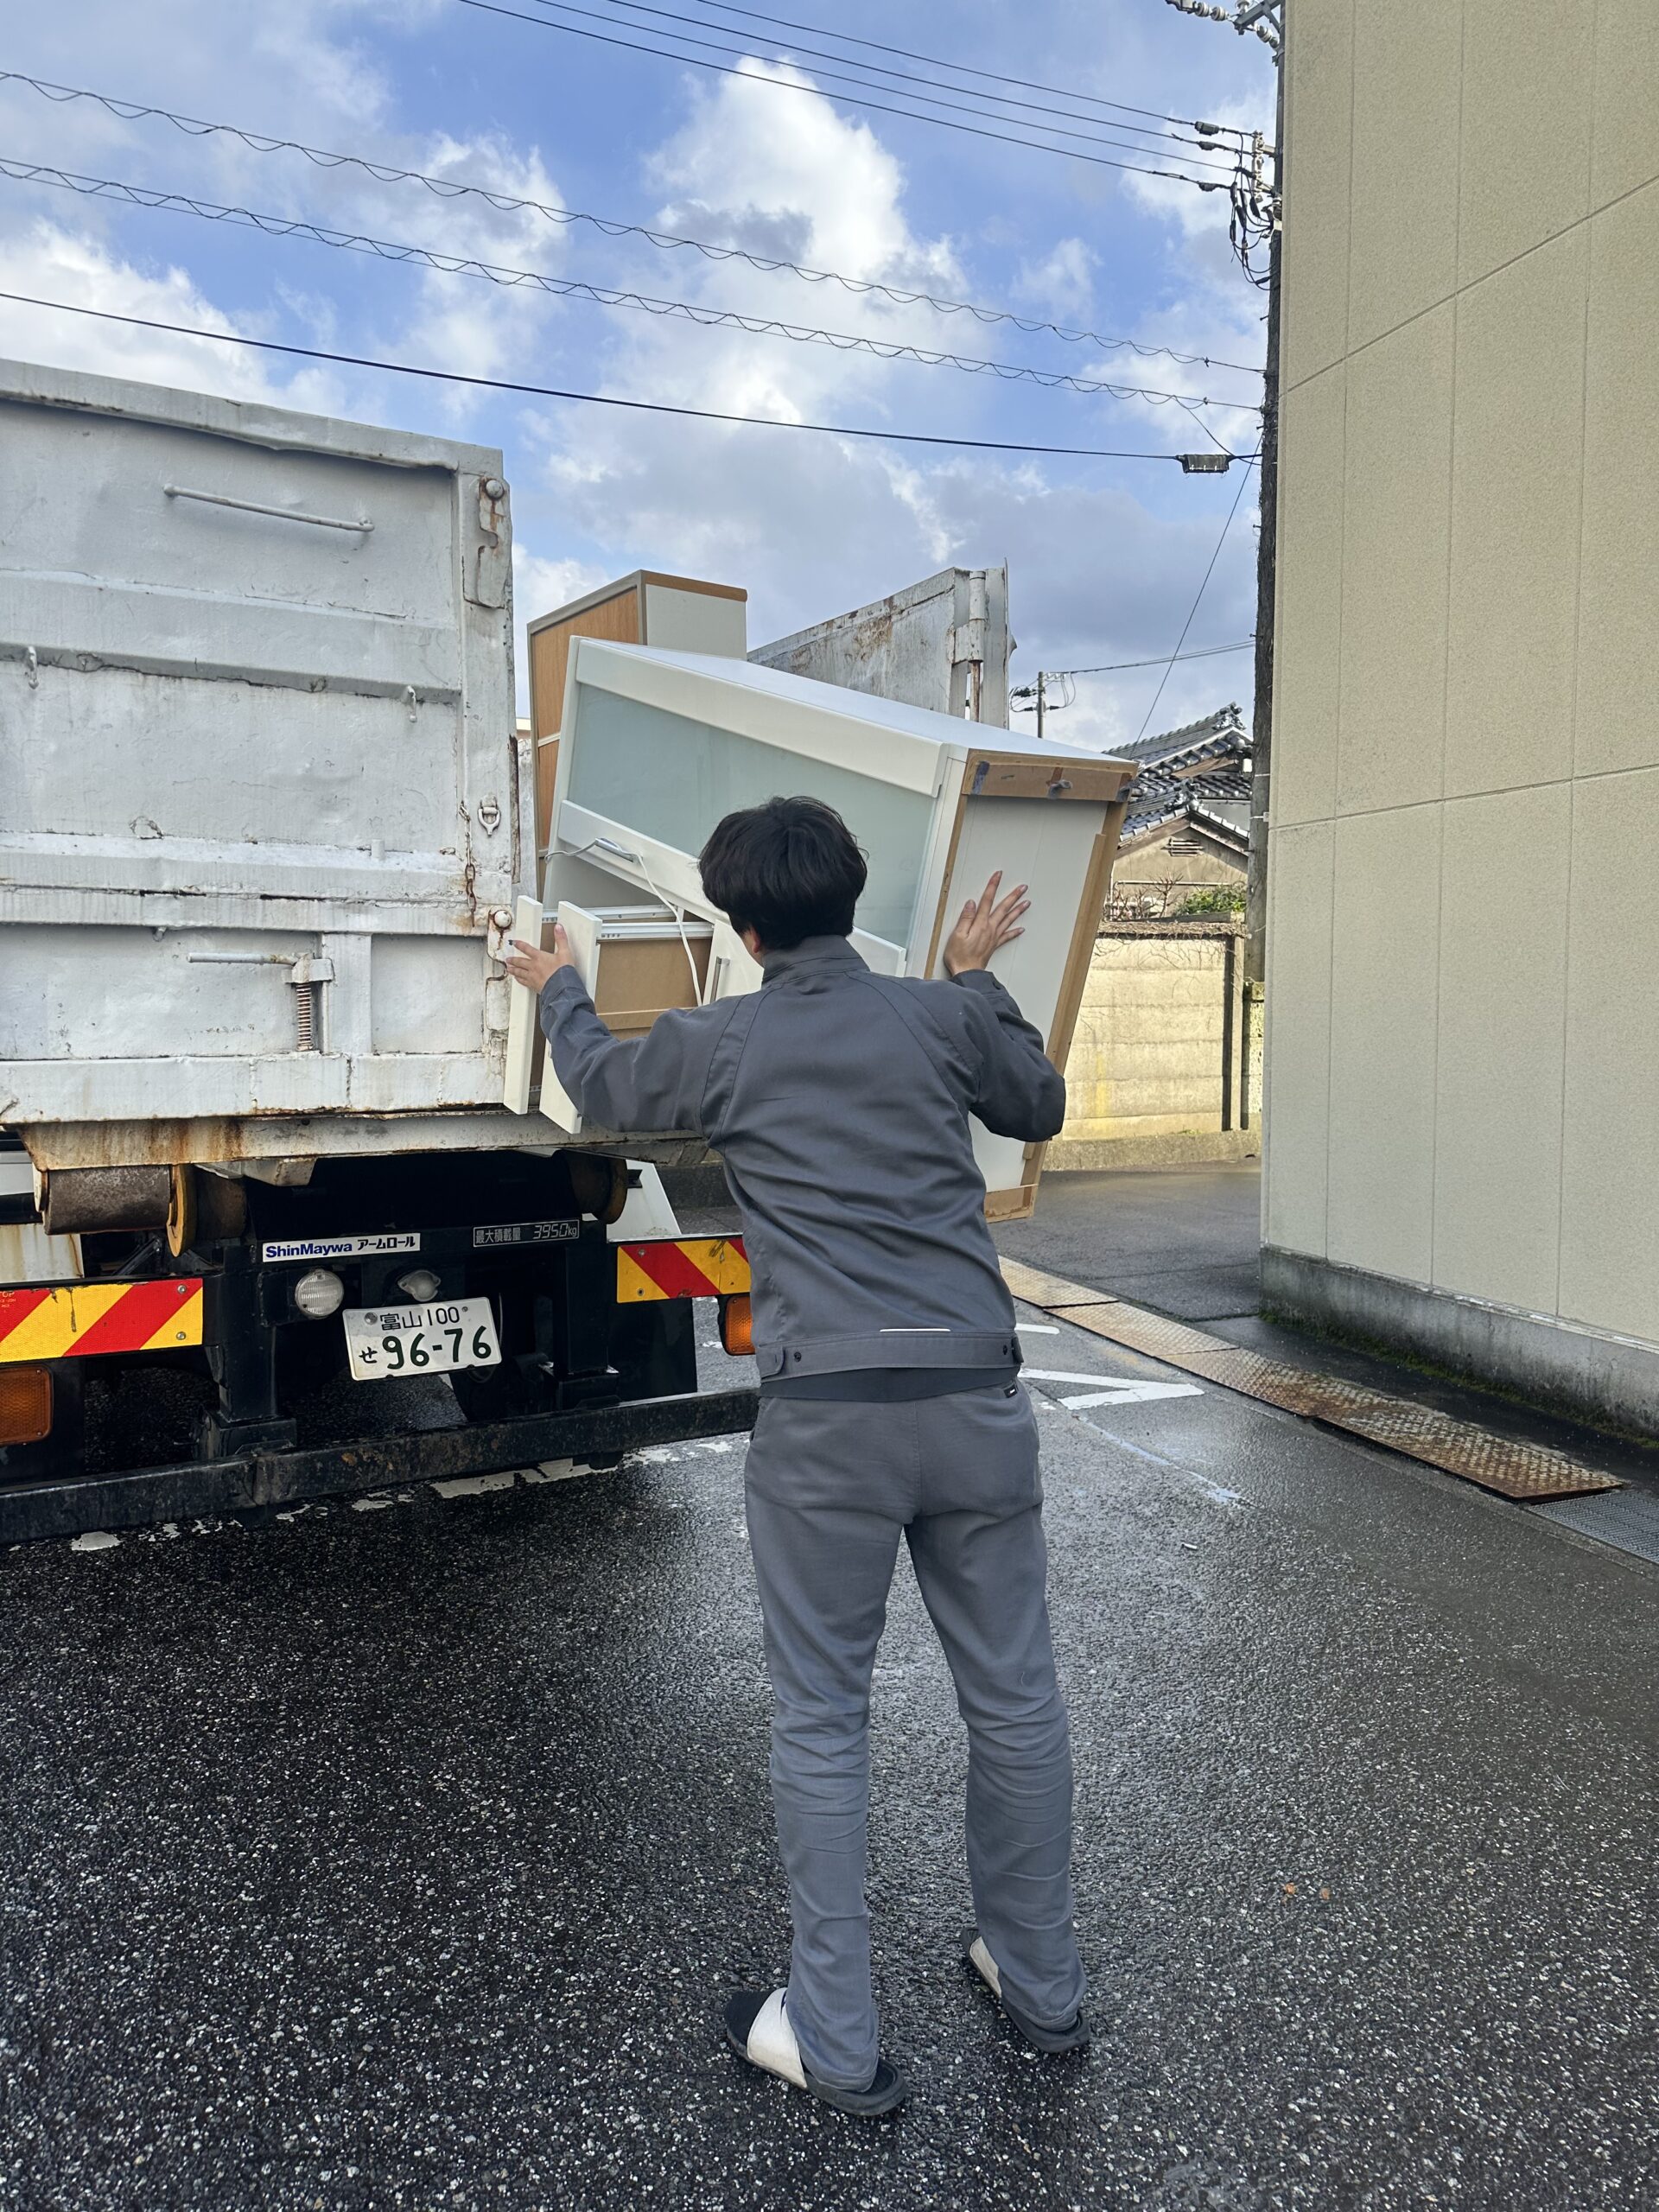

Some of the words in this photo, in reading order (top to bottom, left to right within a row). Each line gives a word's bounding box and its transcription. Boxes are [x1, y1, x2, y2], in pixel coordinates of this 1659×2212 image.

[475, 1227, 521, 1243] 最大積載量
[266, 1243, 353, 1258] ShinMaywa
[358, 1236, 416, 1250] アームロール
[359, 1346, 378, 1363] せ
[382, 1325, 492, 1370] 96-76
